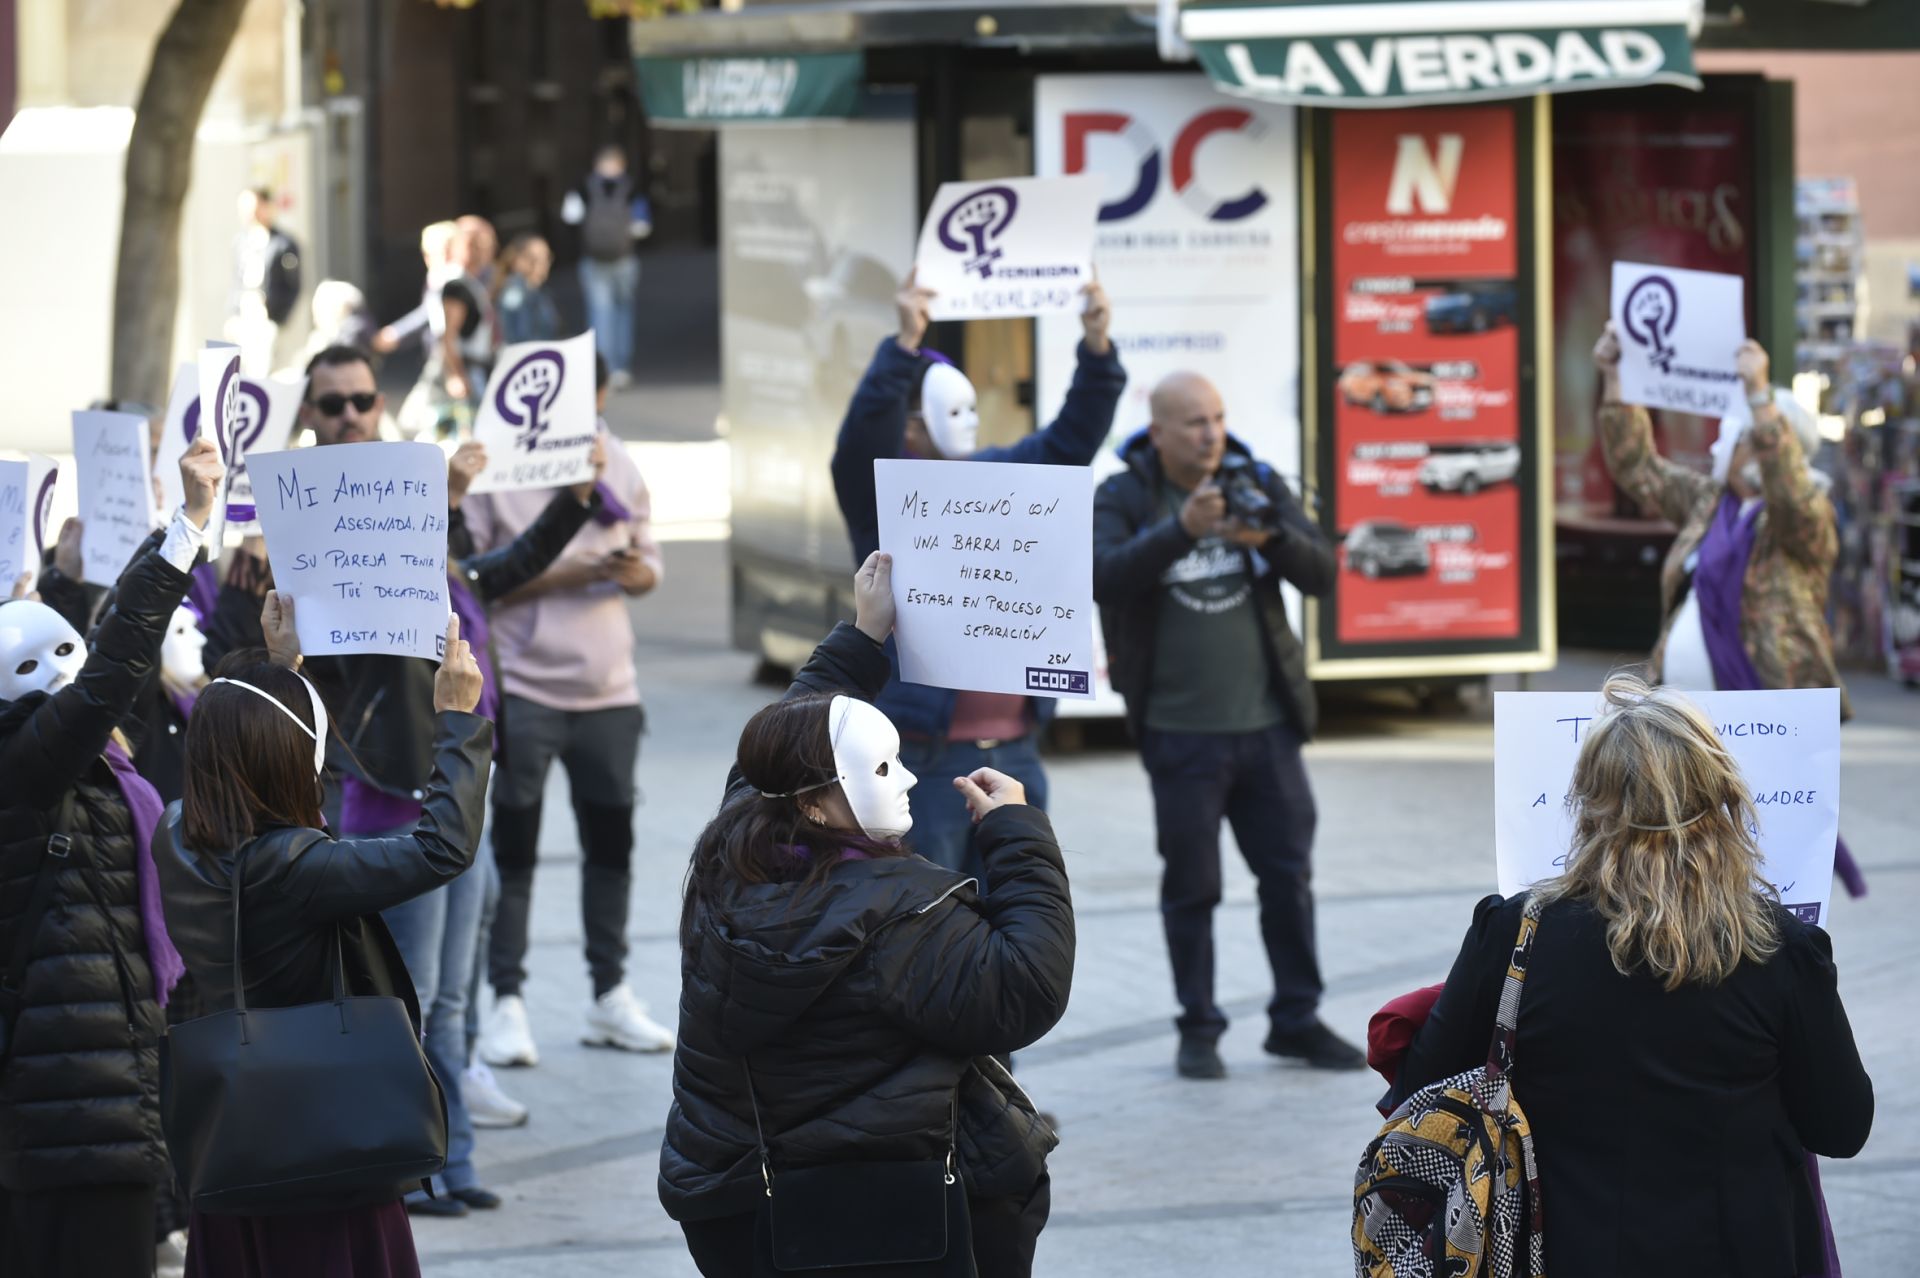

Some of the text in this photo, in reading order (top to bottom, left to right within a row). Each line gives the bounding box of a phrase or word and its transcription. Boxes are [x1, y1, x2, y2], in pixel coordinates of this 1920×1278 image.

[403, 480, 427, 497] FUE
[902, 490, 928, 518] ME
[914, 534, 1038, 553] UNA BARRA DE
[907, 588, 1075, 619] ESTABA EN PROCESO DE
[330, 630, 377, 644] BASTA
[1029, 671, 1069, 689] CCOO
